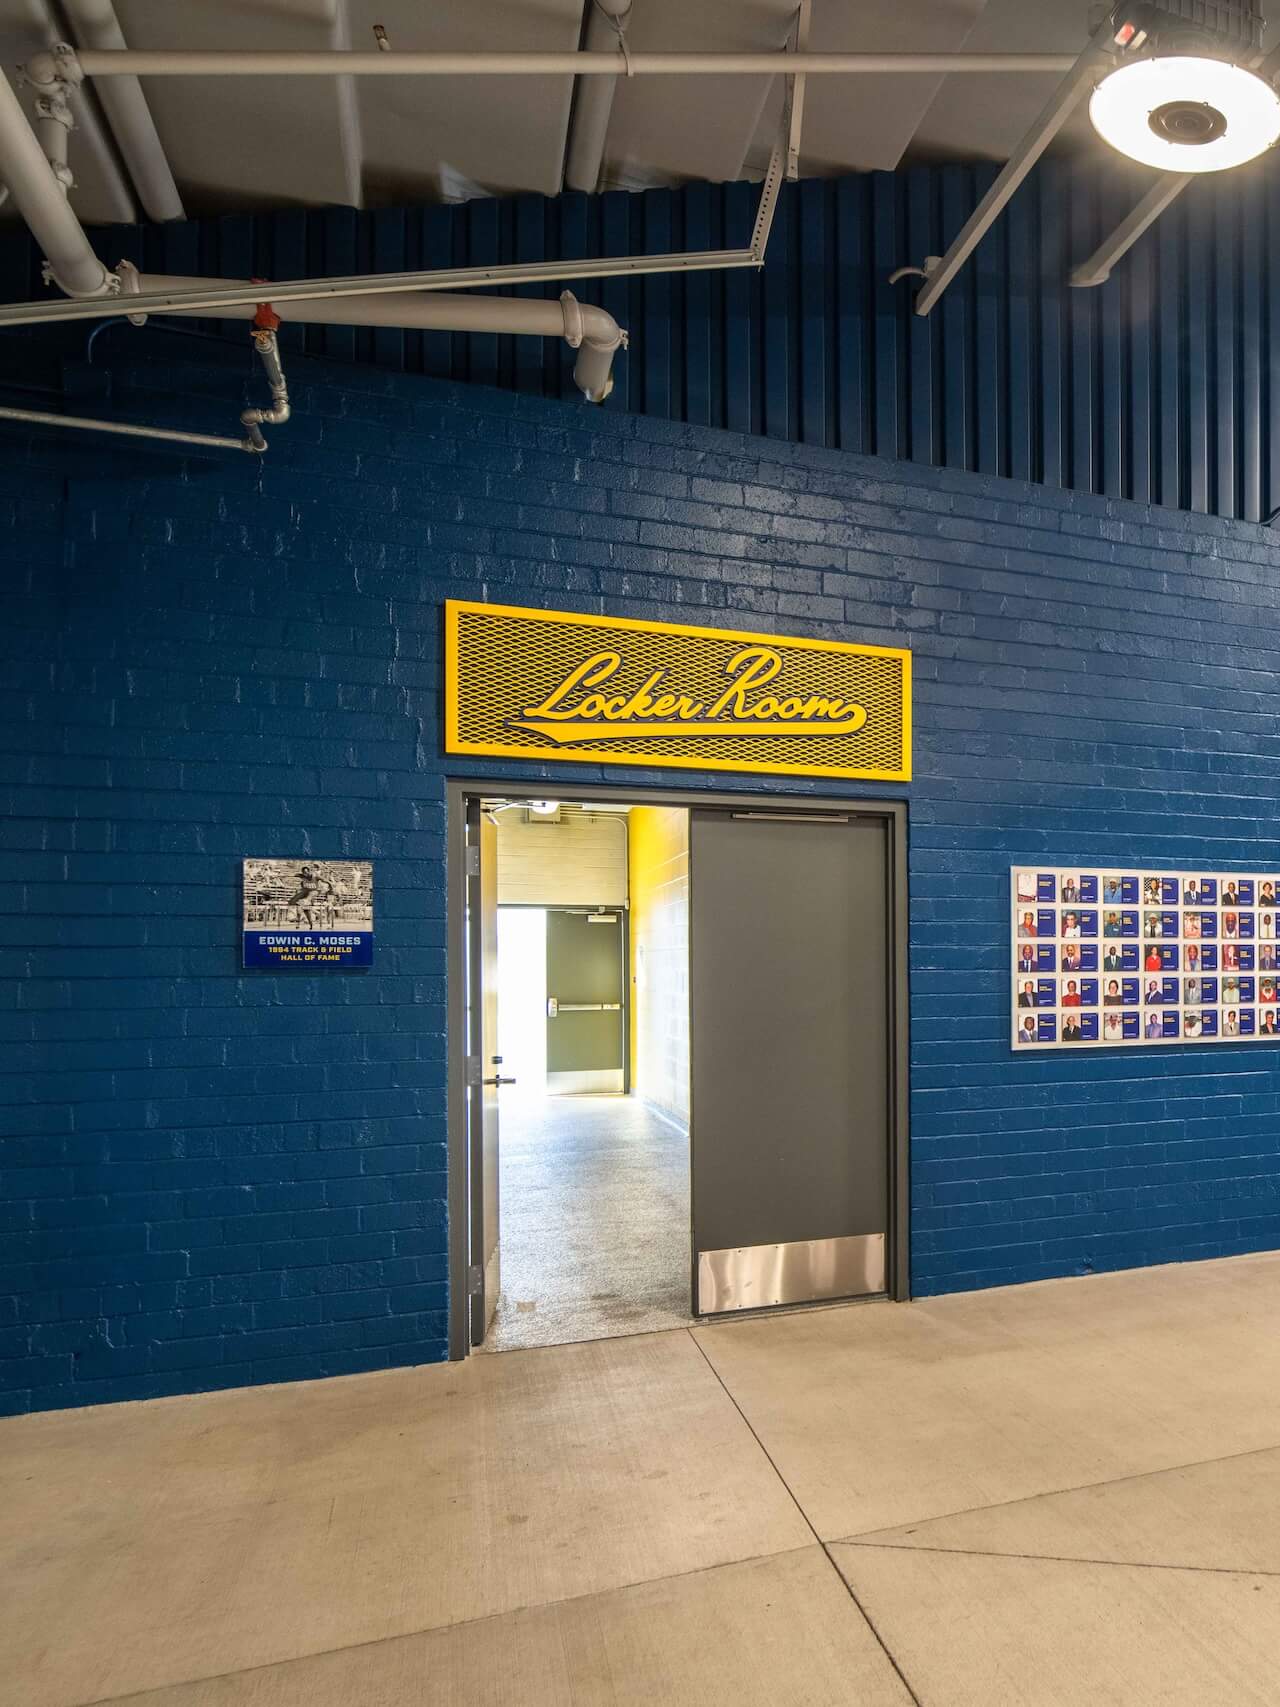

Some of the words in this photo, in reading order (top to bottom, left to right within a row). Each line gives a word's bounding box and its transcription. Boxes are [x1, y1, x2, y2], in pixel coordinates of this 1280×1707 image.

[523, 650, 703, 721] Locker
[706, 648, 854, 720] Room
[259, 937, 300, 945] EDWIN
[304, 937, 315, 945] C.
[319, 937, 361, 945] MOSES
